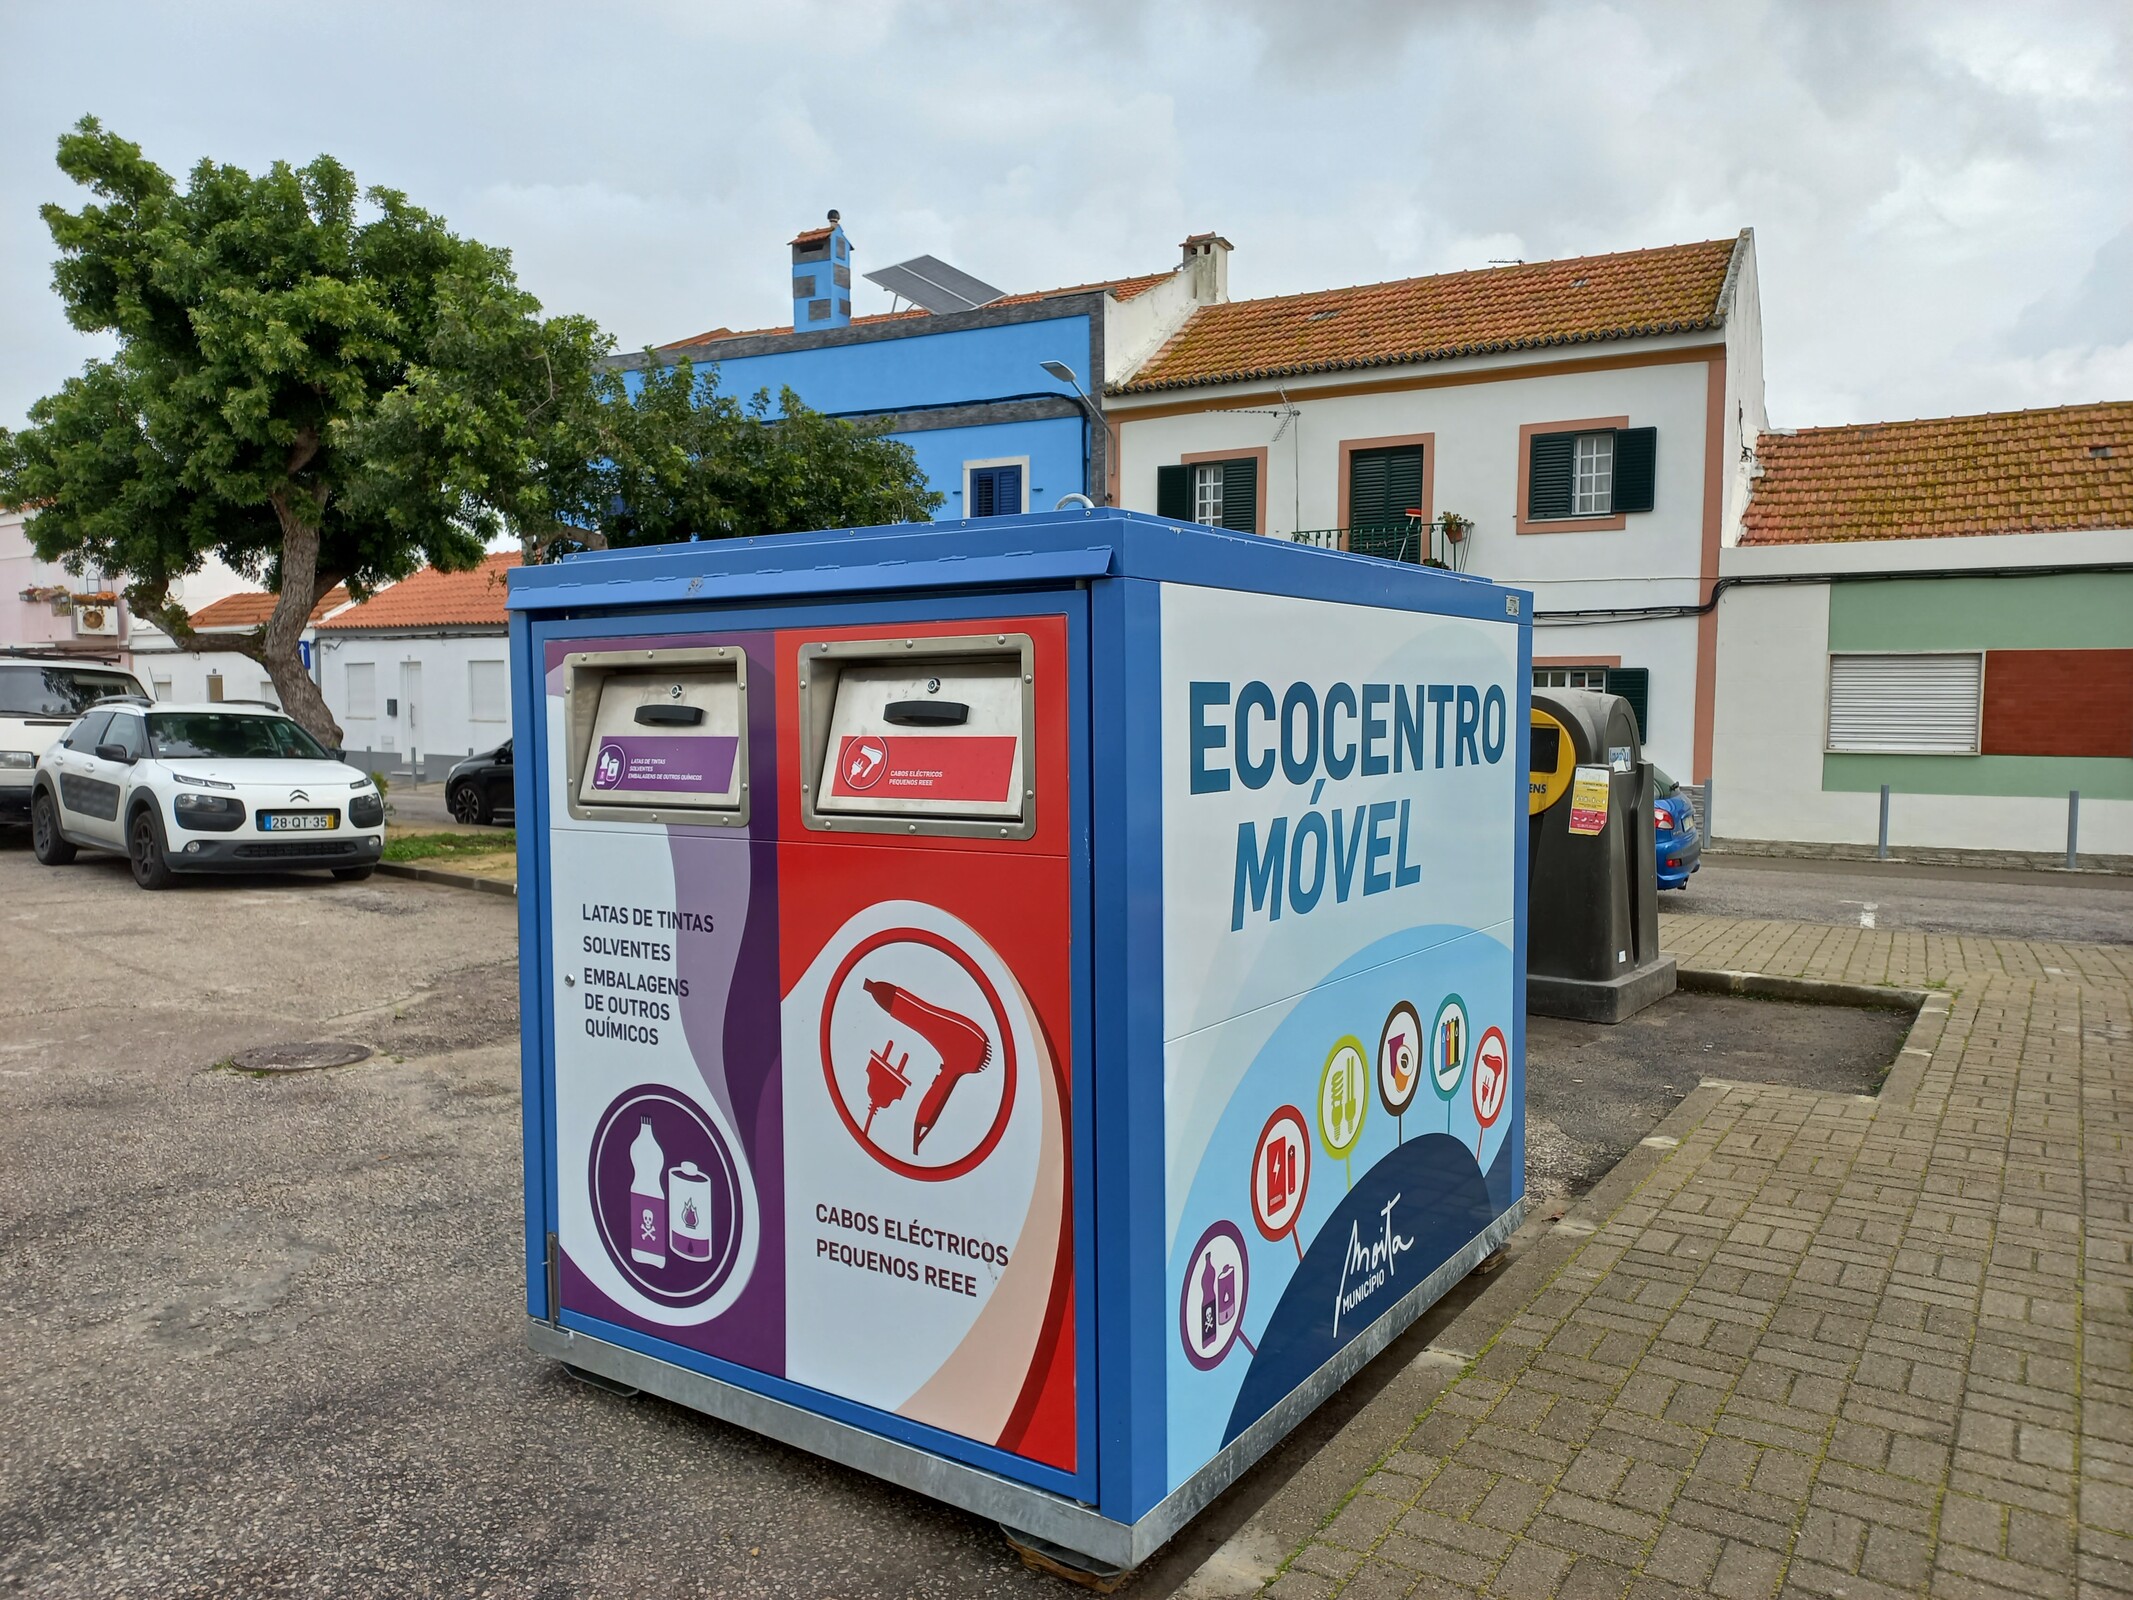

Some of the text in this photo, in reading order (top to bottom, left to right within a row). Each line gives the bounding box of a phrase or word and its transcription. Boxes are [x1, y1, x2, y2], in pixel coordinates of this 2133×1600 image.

[1189, 680, 1506, 796] ECOCENTRO
[888, 778, 918, 786] PEQUENOS
[909, 769, 943, 778] ELÉCTRICOS
[1231, 778, 1421, 932] MÓVEL
[582, 903, 714, 933] LATAS DE TINTAS
[583, 935, 671, 962] SOLVENTES
[584, 967, 690, 997] EMBALAGENS
[584, 992, 670, 1021] DE OUTROS
[585, 1015, 659, 1046] QUÍMICOS
[815, 1203, 1009, 1267] CABOS ELÉCTRICOS
[816, 1238, 977, 1298] PEQUENOS REEE
[1342, 1268, 1385, 1315] MUNICÍPIO
